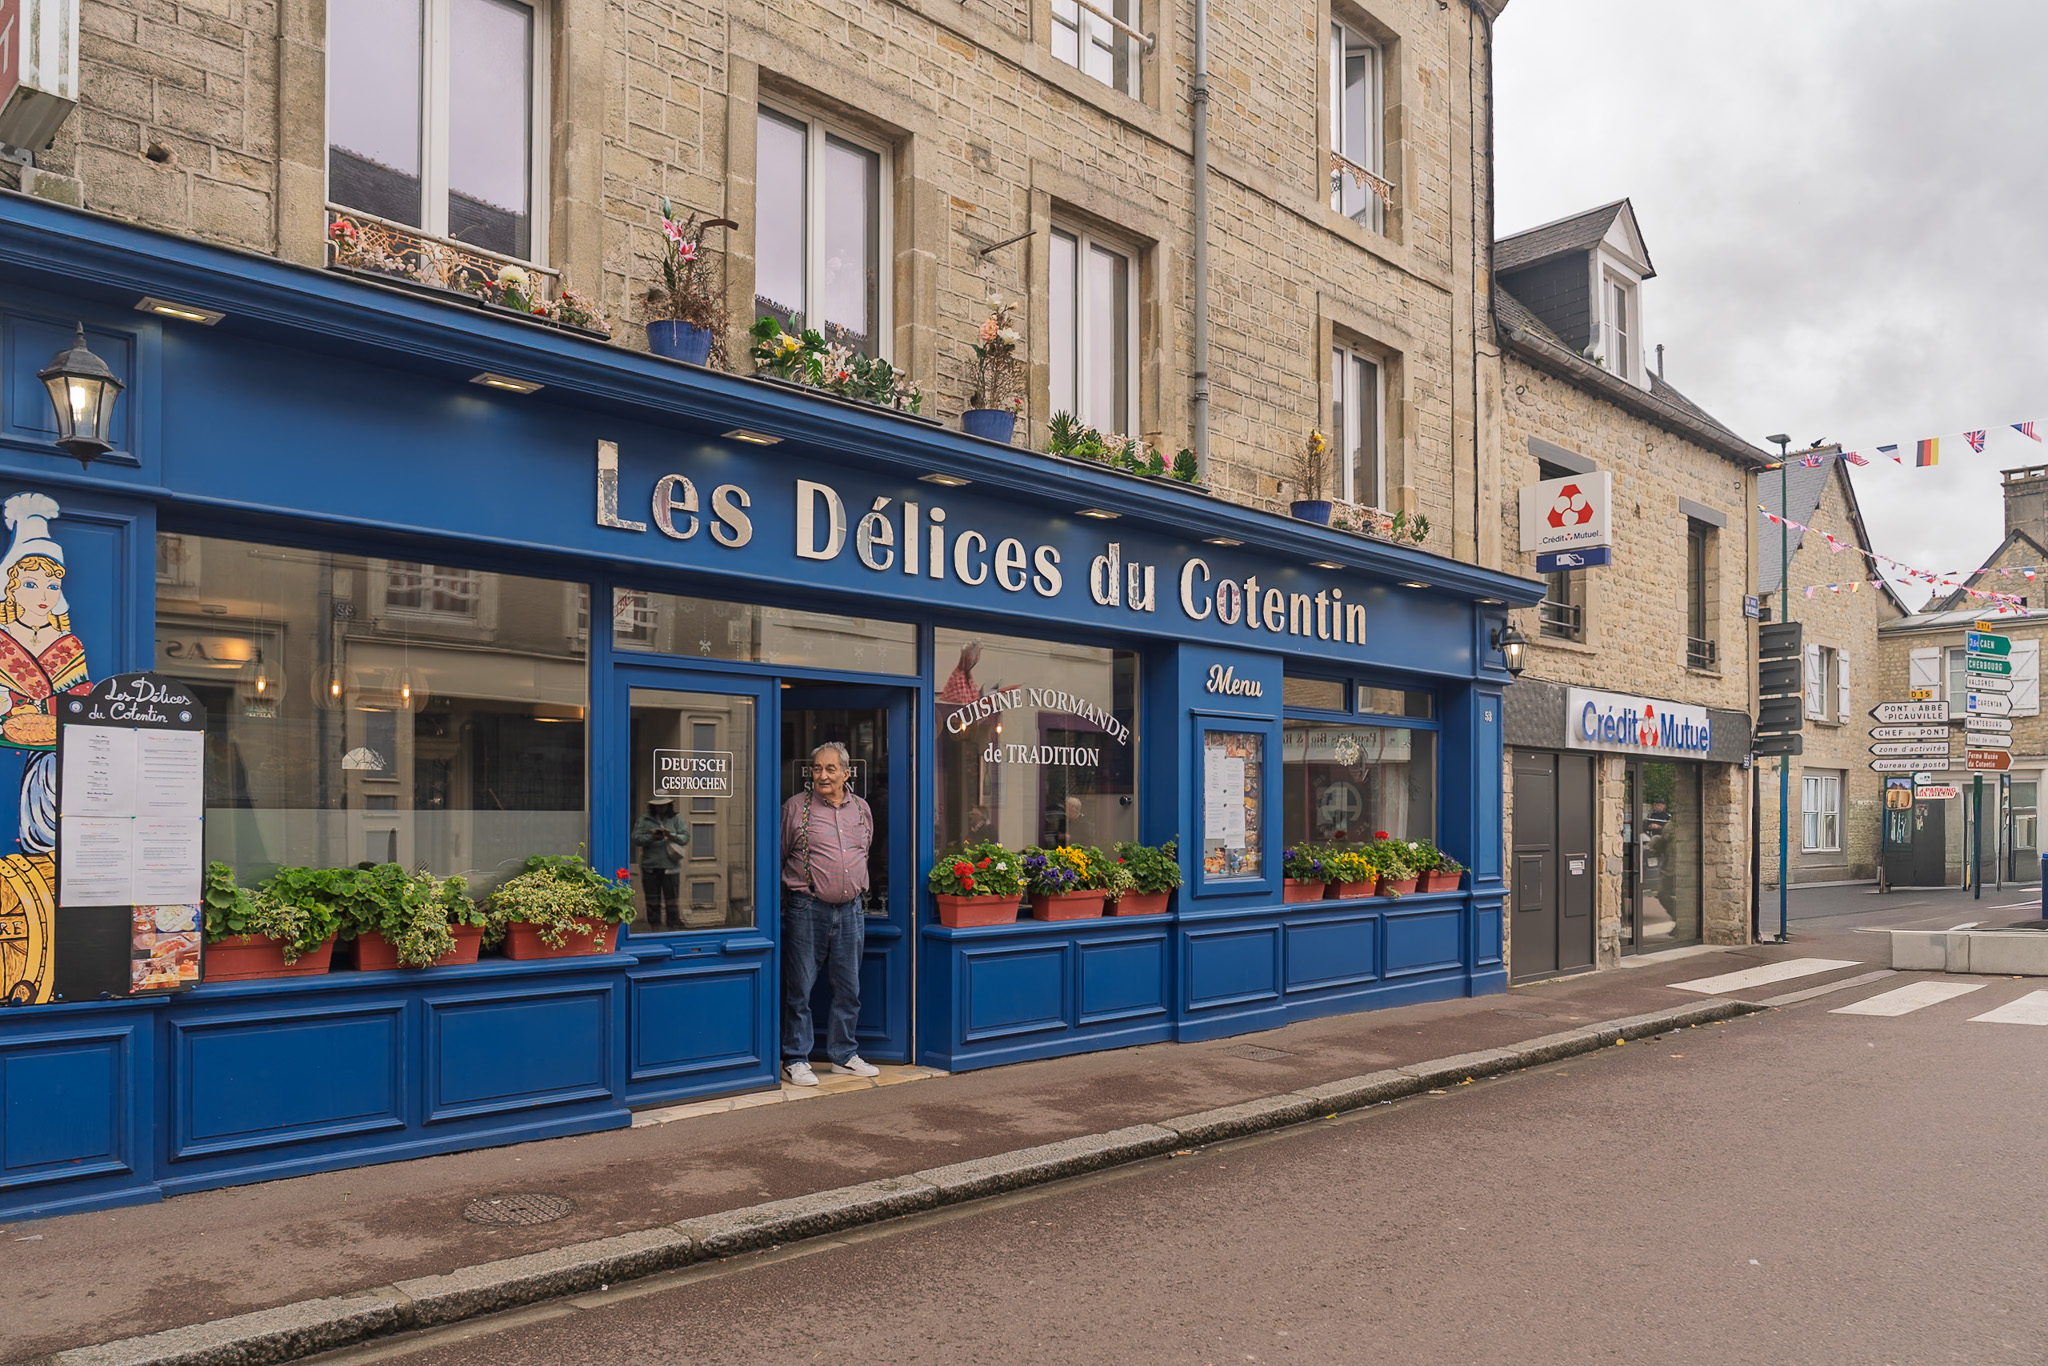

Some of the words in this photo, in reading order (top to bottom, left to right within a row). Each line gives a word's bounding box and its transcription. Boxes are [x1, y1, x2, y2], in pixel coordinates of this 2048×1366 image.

[597, 439, 753, 548] Les
[797, 479, 1063, 597] Délices
[1090, 542, 1155, 611] du
[1180, 558, 1366, 645] Cotentin
[1542, 535, 1564, 544] Crédit
[1573, 530, 1599, 539] Mutuel
[1980, 639, 1995, 649] CAEN
[1968, 660, 2003, 671] CHERBOURG
[1207, 664, 1263, 697] Menu
[105, 679, 135, 702] Les
[131, 677, 192, 705] Délices
[88, 704, 105, 720] du
[110, 702, 168, 723] Cotentin
[946, 688, 1023, 734] CUISINE
[1028, 687, 1130, 746] NORMANDE
[1582, 701, 1638, 745] Crédit
[1660, 713, 1712, 752] Mutuel
[1878, 729, 1904, 737] CHEF
[1920, 728, 1946, 736] PONT
[983, 742, 1003, 763] de
[1005, 743, 1100, 767] TRADITION
[1901, 744, 1947, 753] d'activités
[661, 757, 726, 772] DEUTSCH
[1878, 761, 1907, 769] bureau
[1909, 761, 1920, 769] de
[1922, 761, 1946, 770] poste
[661, 776, 727, 791] GESPROCHEN
